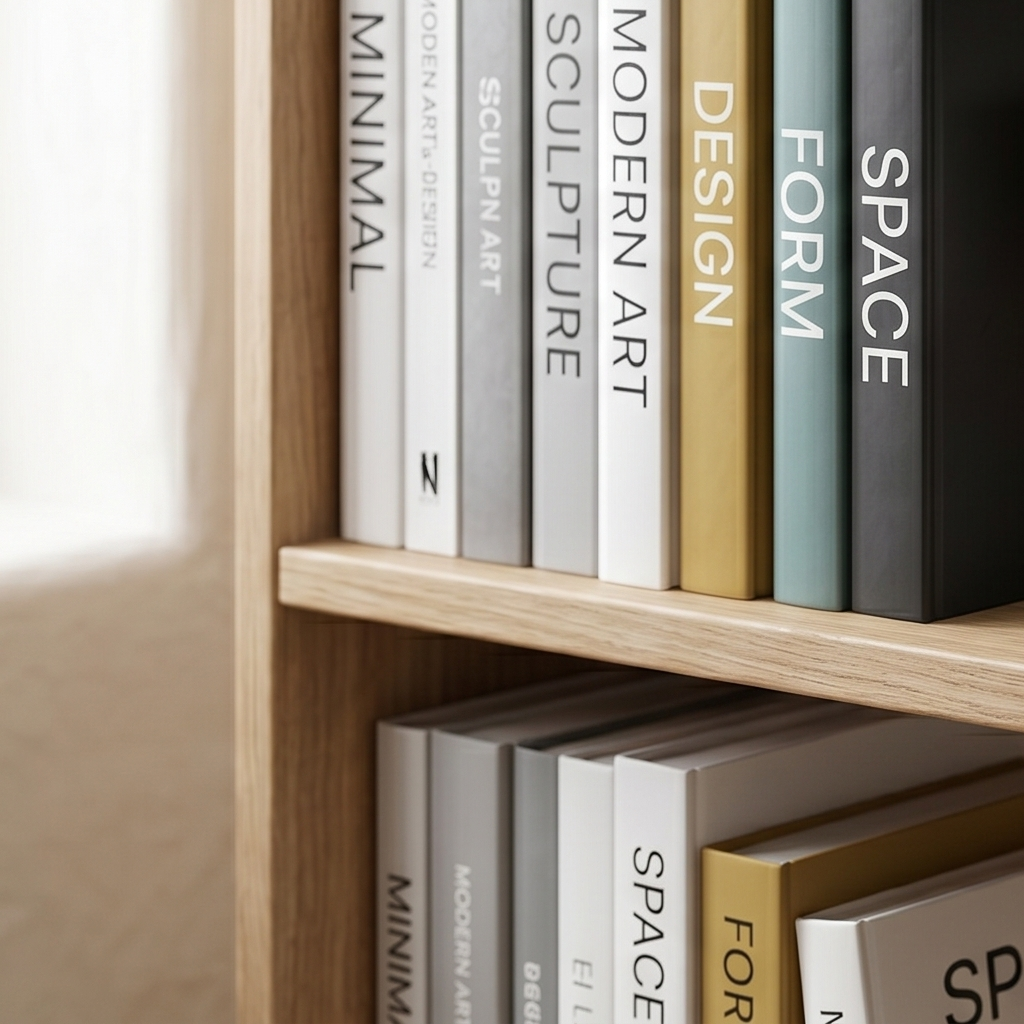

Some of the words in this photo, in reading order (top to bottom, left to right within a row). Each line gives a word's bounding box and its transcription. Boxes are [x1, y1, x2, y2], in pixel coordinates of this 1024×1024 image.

[350, 13, 385, 292] MINIMAL
[546, 13, 581, 378] SCULPTURE
[612, 8, 648, 269] MODERN
[693, 81, 734, 327] DESIGN
[780, 128, 825, 340] FORM
[478, 227, 502, 296] ART
[612, 289, 648, 409] ART
[861, 144, 911, 388] SPACE
[633, 846, 665, 1024] SPACE
[723, 915, 755, 1024] FOR
